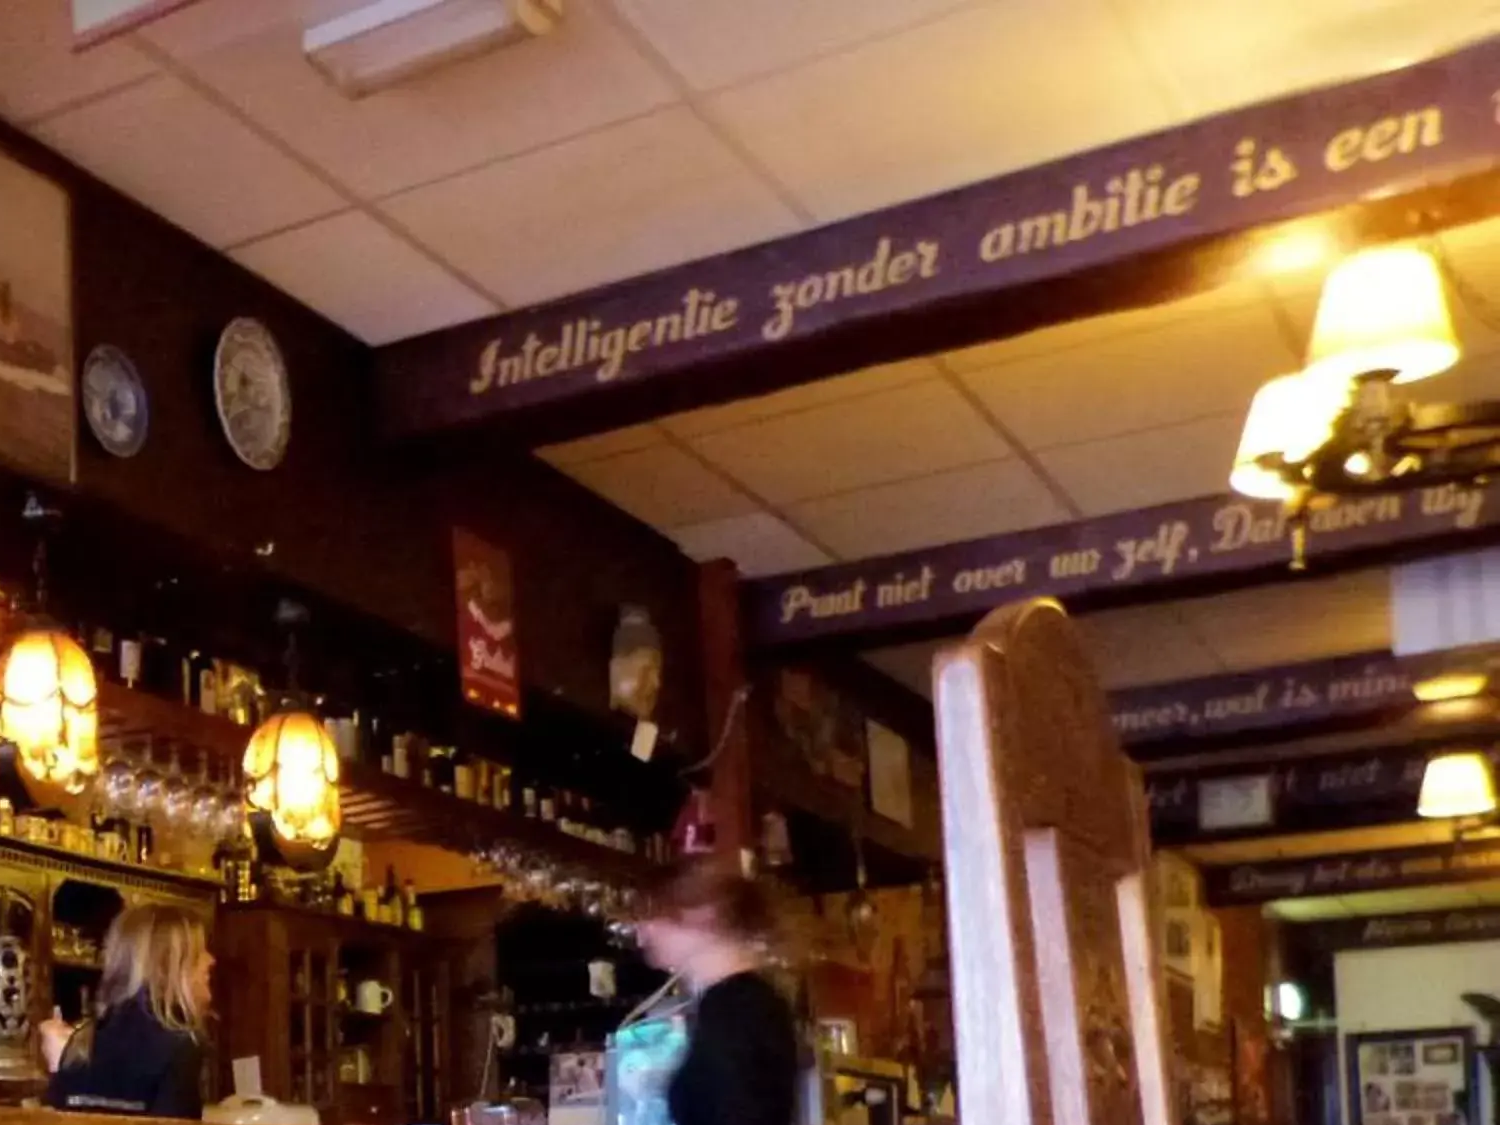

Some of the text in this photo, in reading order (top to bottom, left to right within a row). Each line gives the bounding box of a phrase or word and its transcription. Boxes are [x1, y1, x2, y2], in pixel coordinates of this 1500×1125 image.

[469, 104, 1443, 394] Intelligentie zonder ambitie is een
[780, 577, 866, 623] Praat
[876, 566, 934, 608] niet
[953, 558, 1026, 593] over
[1051, 548, 1103, 579] uw
[1281, 677, 1318, 709] is
